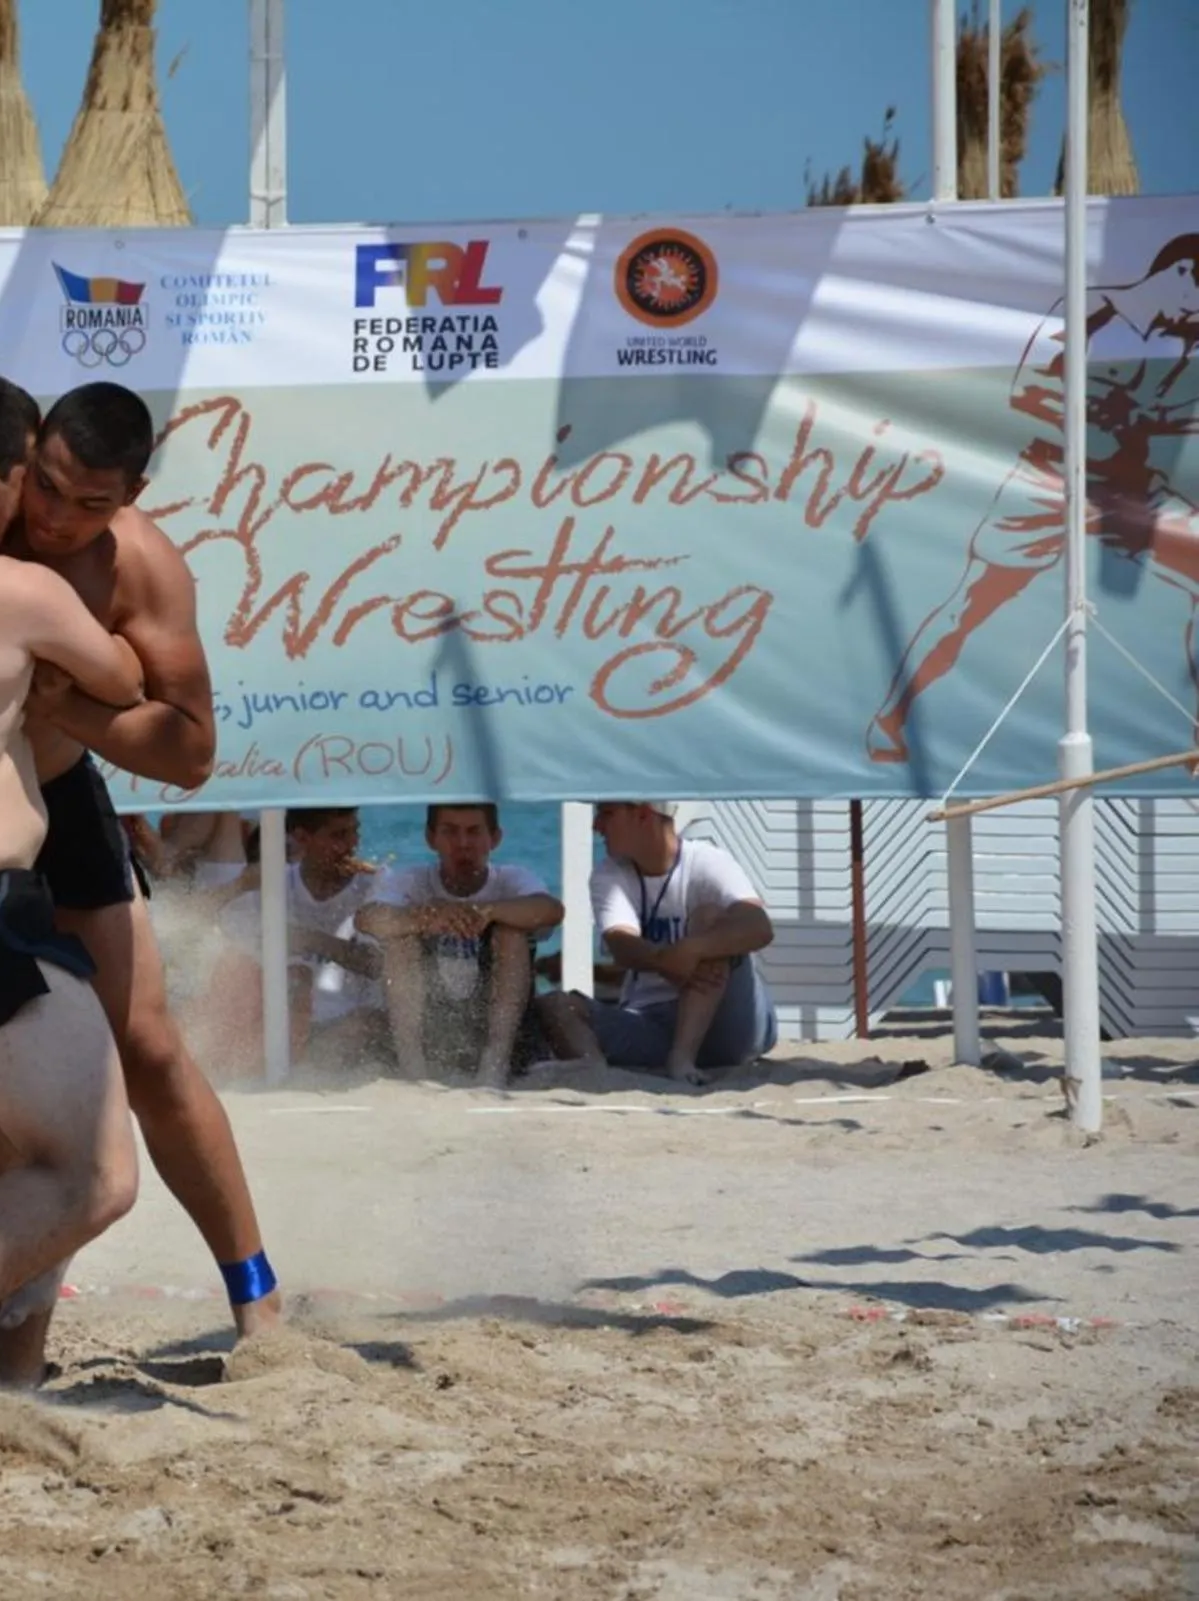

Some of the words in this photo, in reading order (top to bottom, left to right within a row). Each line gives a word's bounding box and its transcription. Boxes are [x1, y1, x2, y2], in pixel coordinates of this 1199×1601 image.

[354, 239, 503, 308] FRL
[175, 292, 258, 308] OLIMPIC
[66, 307, 143, 329] ROMANIA
[354, 315, 498, 336] FEDERATIA
[353, 334, 498, 354] ROMANA
[353, 355, 387, 372] DE
[412, 351, 499, 371] LUPTE
[617, 348, 718, 366] WRESTLING
[178, 516, 773, 719] Wrestling
[237, 680, 348, 729] junior
[359, 669, 439, 711] and
[452, 674, 574, 706] senior
